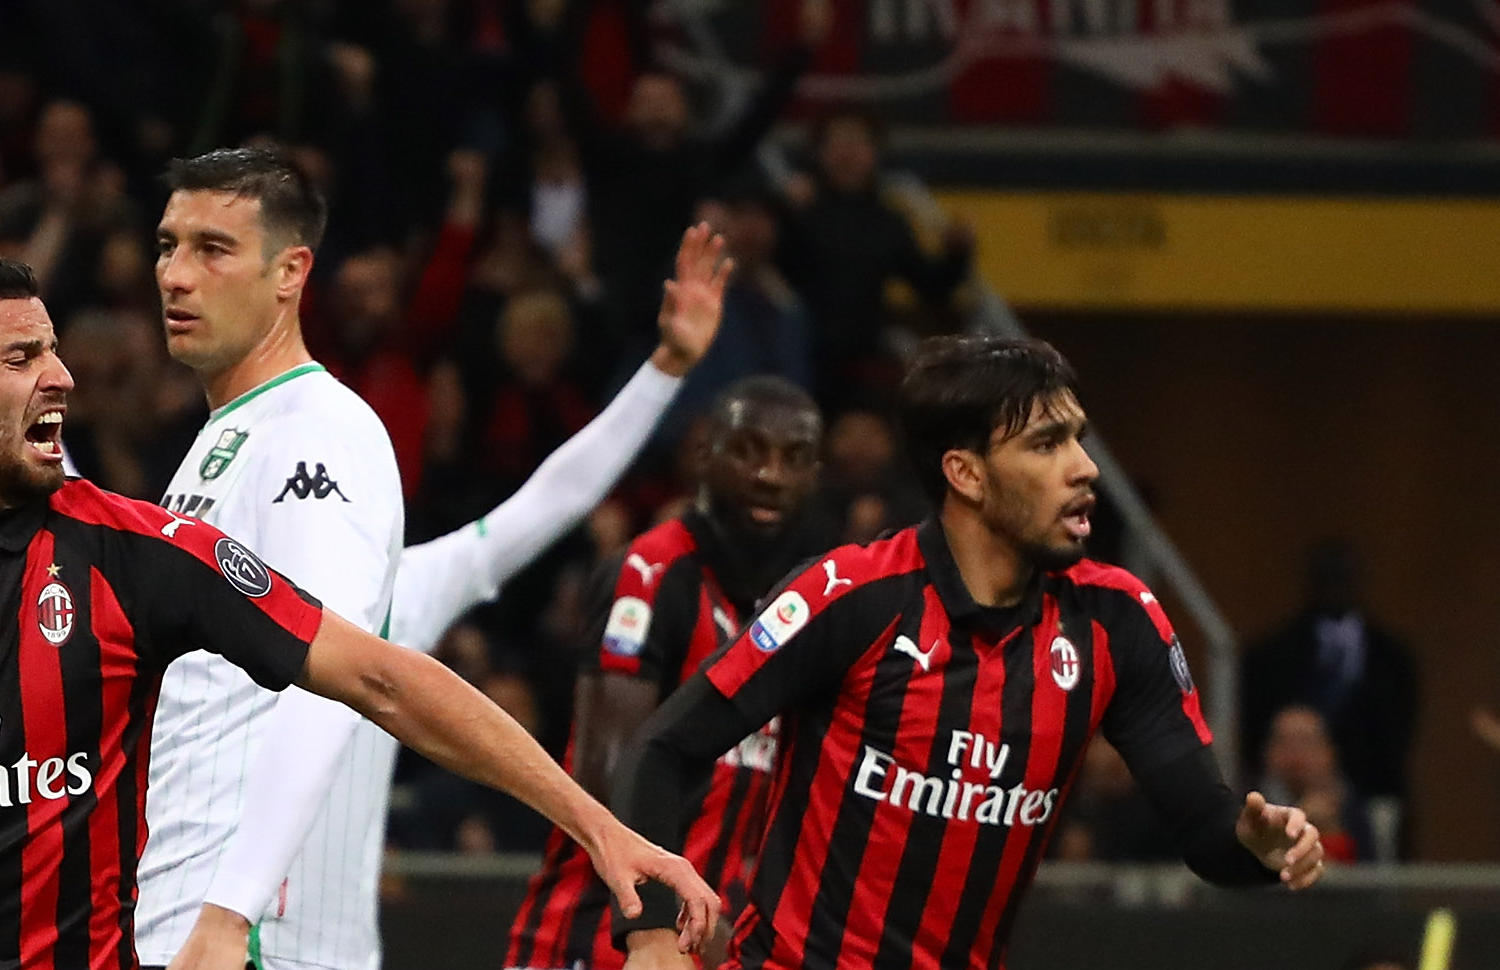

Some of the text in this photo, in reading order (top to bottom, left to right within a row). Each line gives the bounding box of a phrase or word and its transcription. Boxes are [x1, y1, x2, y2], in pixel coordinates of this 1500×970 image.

[44, 585, 66, 598] ACM
[47, 630, 67, 639] 1899
[948, 729, 1010, 779] Fly
[853, 745, 1059, 827] Emirates
